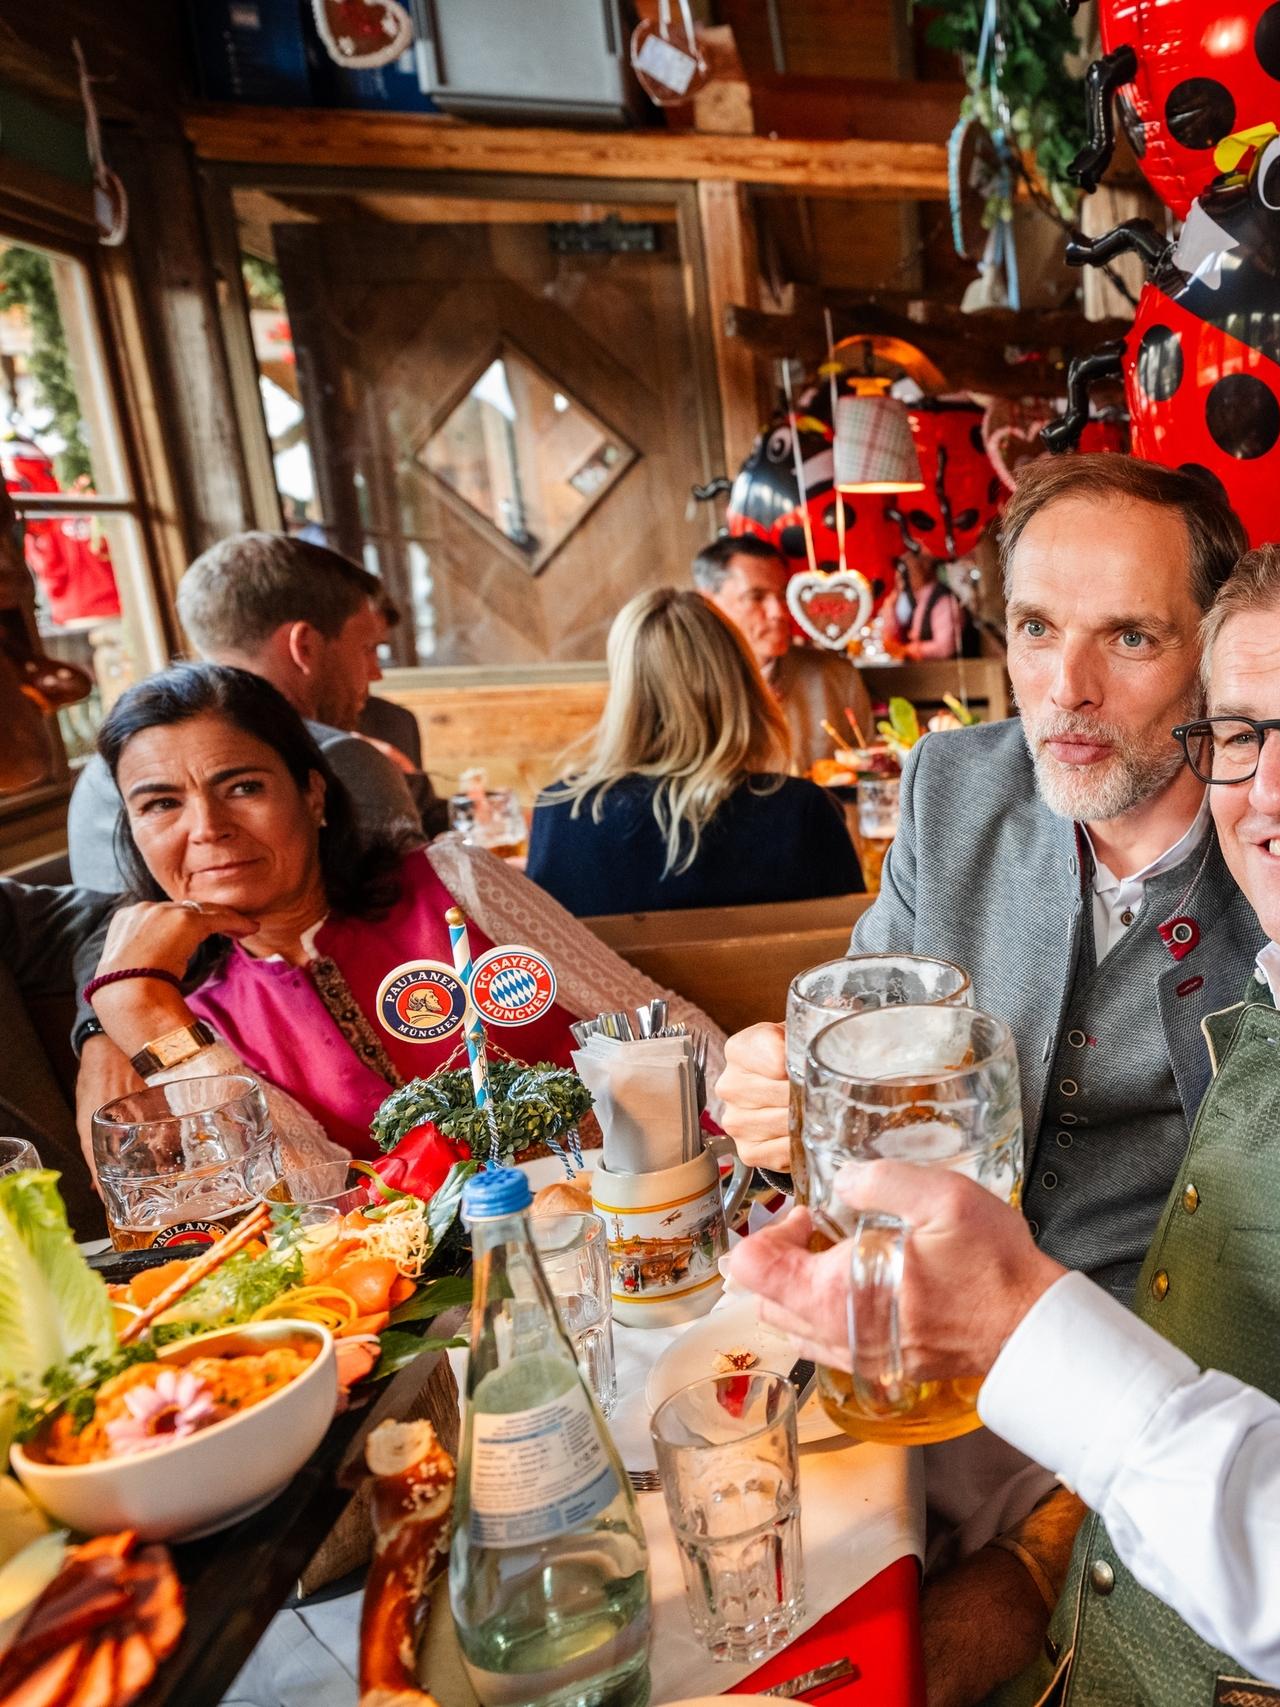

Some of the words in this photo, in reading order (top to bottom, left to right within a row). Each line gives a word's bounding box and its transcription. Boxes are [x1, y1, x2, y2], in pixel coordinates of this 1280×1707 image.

[385, 971, 458, 1003] PAULANER
[477, 972, 491, 989] FC
[491, 957, 545, 980] BAYERN
[481, 989, 549, 1020] MÜNCHEN
[398, 1014, 460, 1038] MÜNCHEN
